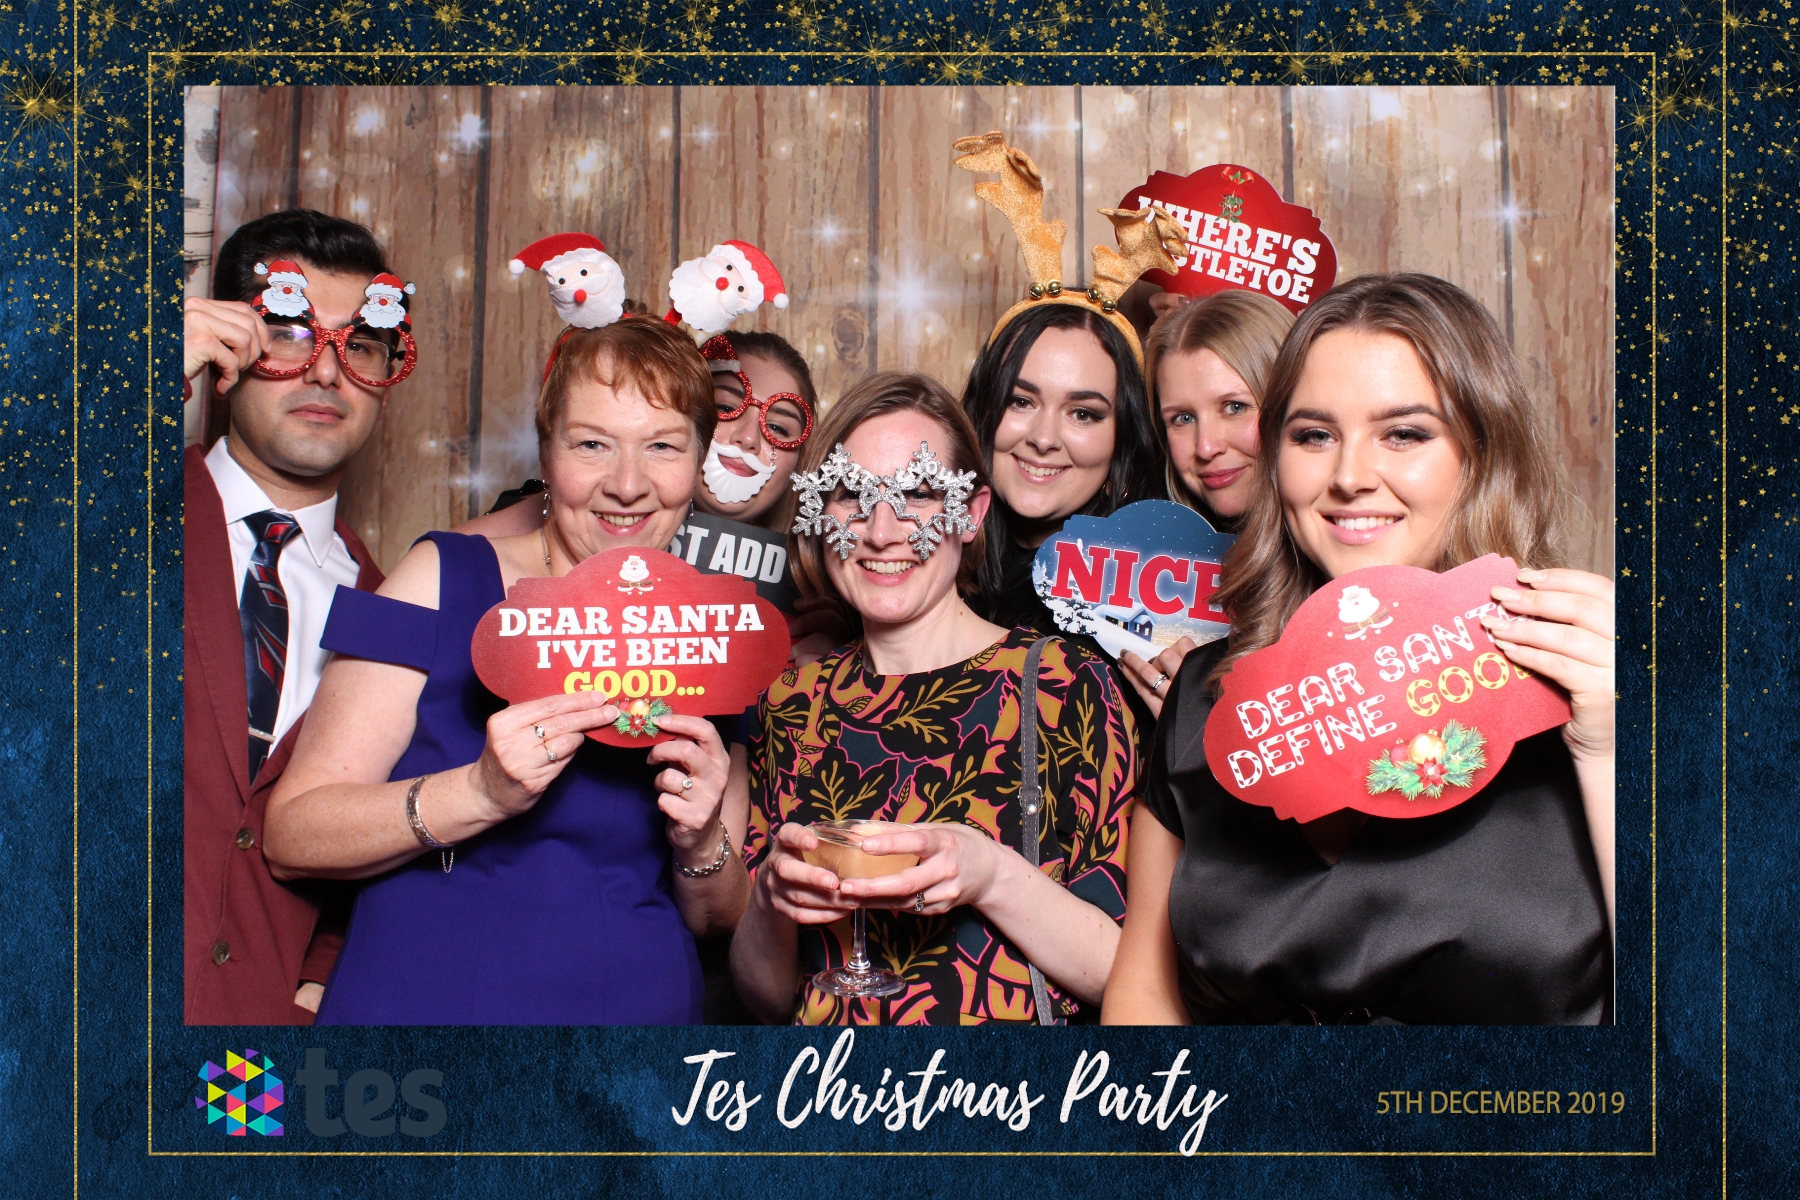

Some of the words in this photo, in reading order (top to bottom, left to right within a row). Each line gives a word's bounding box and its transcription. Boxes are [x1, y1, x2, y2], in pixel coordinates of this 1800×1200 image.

[709, 532, 787, 584] ADD
[498, 606, 612, 637] DEAR
[622, 603, 765, 634] SANTA
[536, 639, 616, 669] I'VE
[626, 636, 730, 667] BEEN
[563, 669, 706, 699] GOOD...
[1235, 662, 1365, 740] DEAR
[1227, 694, 1397, 789] DEFINE
[1406, 652, 1532, 717] GOO
